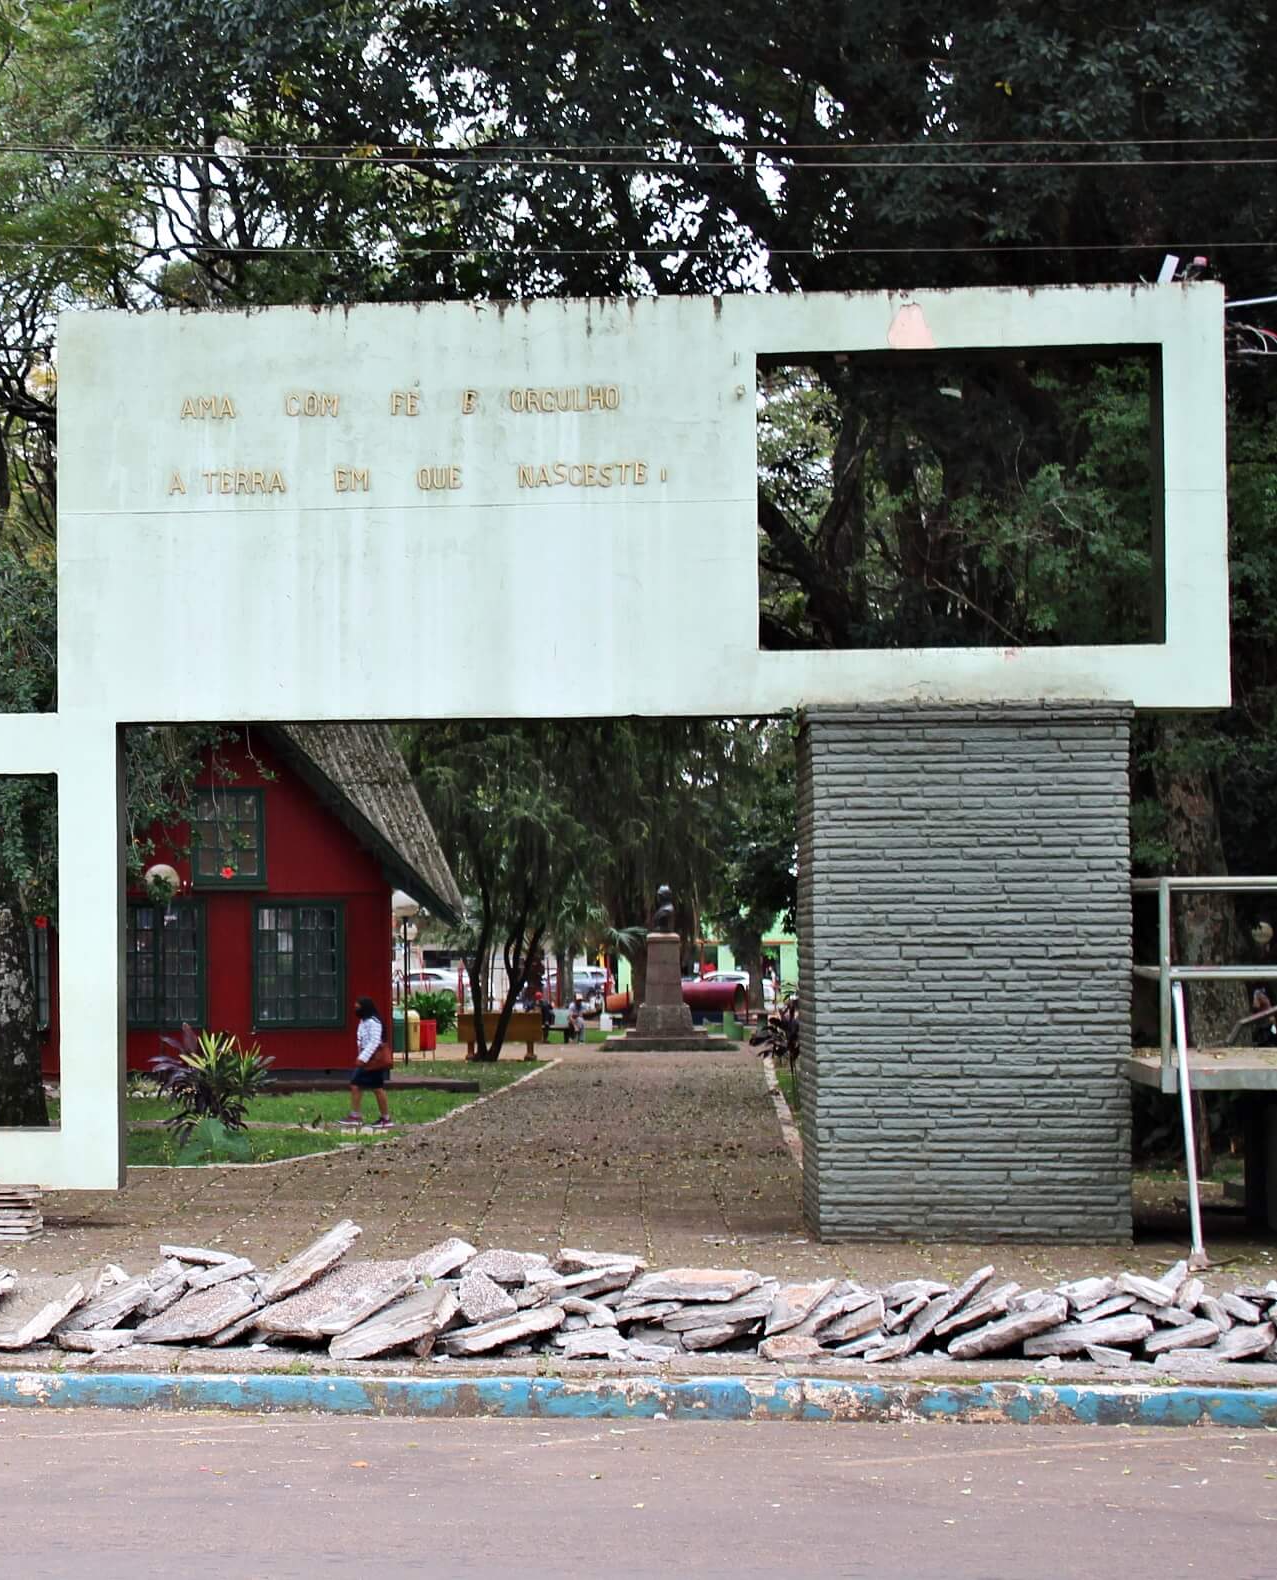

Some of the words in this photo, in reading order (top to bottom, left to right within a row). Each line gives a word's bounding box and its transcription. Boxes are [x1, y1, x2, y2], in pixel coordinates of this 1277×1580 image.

[180, 393, 236, 420] AMA
[285, 392, 340, 417] COM
[169, 471, 186, 495] A
[202, 469, 286, 495] TERRA
[333, 467, 369, 492] EM
[417, 465, 462, 490] QUE
